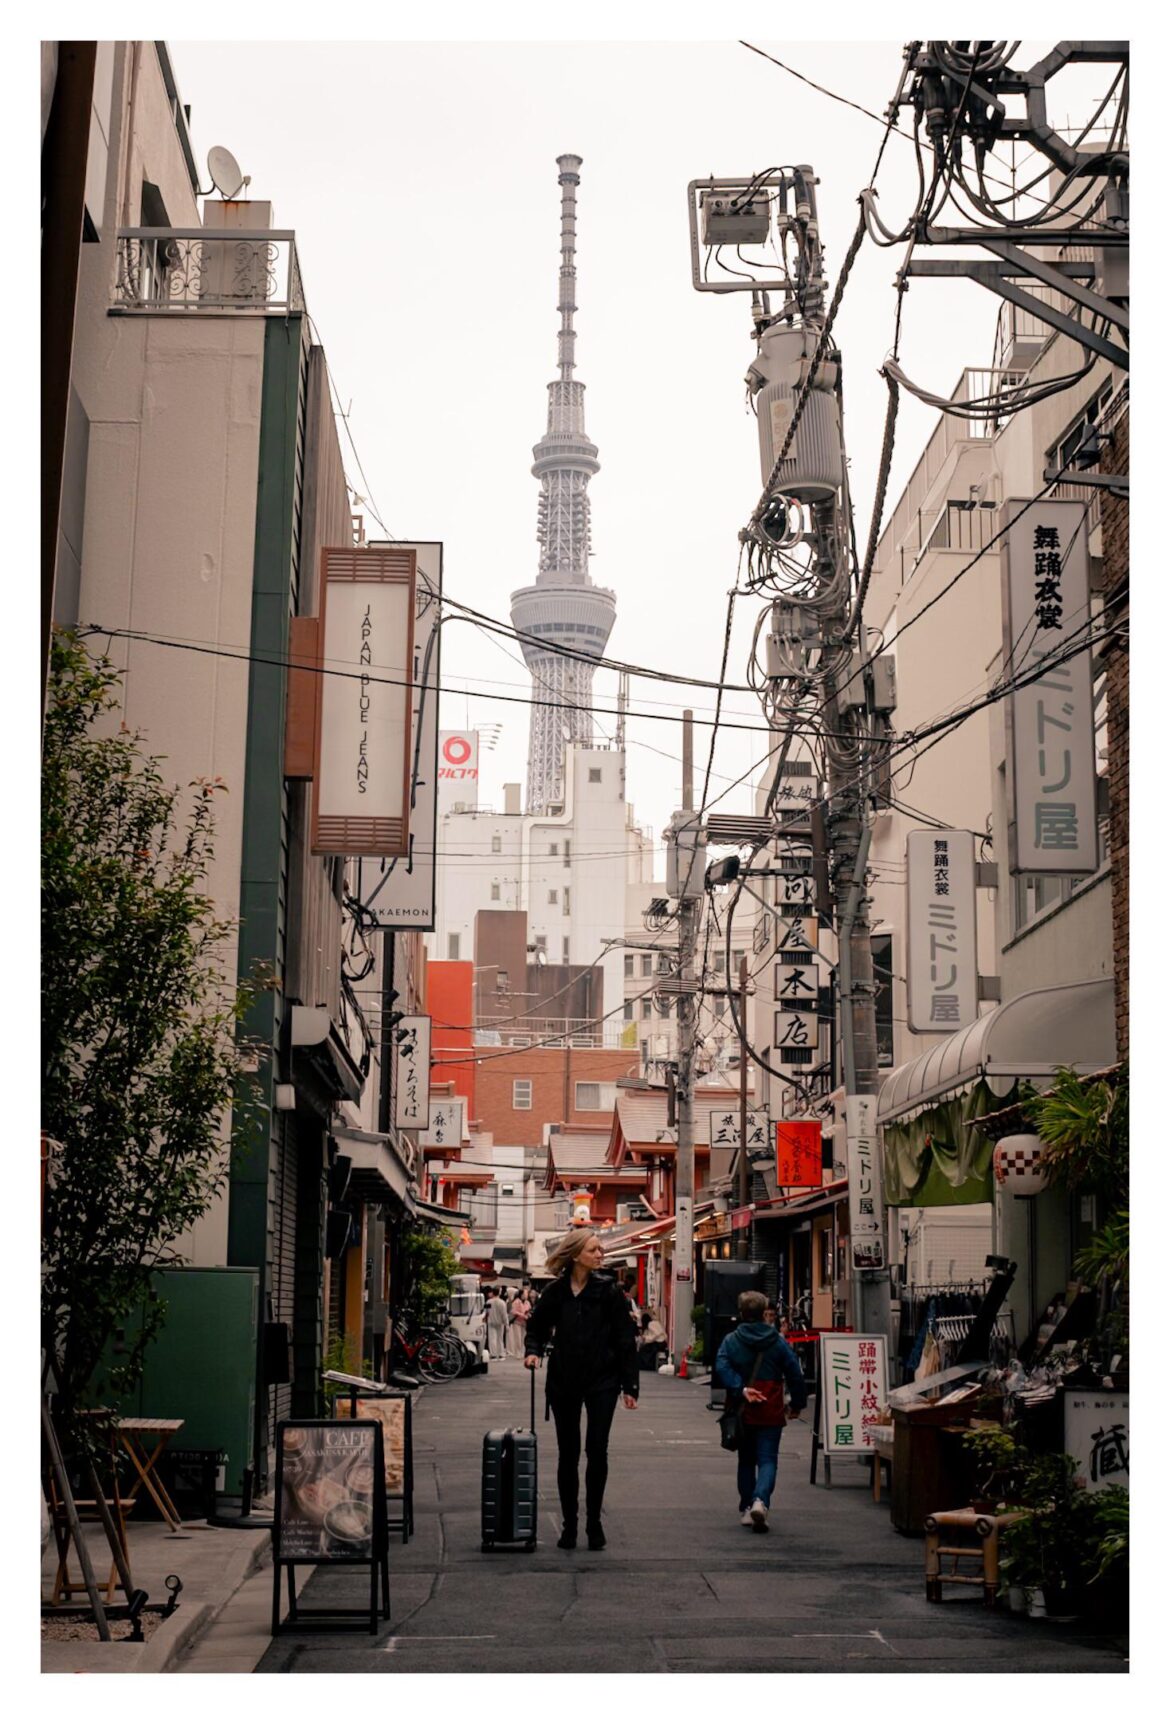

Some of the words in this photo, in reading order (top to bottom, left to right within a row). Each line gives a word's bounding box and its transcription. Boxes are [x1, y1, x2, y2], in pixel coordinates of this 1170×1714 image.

[1033, 525, 1063, 631] 舞踊衣裳
[359, 604, 372, 665] JAPAN
[359, 673, 370, 723] BLUE
[356, 731, 369, 794] JEANS
[1031, 649, 1079, 851] ミドリ屋
[934, 839, 950, 896] 舞踊衣裳
[927, 903, 961, 1022] ミドリ屋
[857, 1140, 874, 1215] ミドリ屋
[832, 1351, 855, 1446] ミドリ屋
